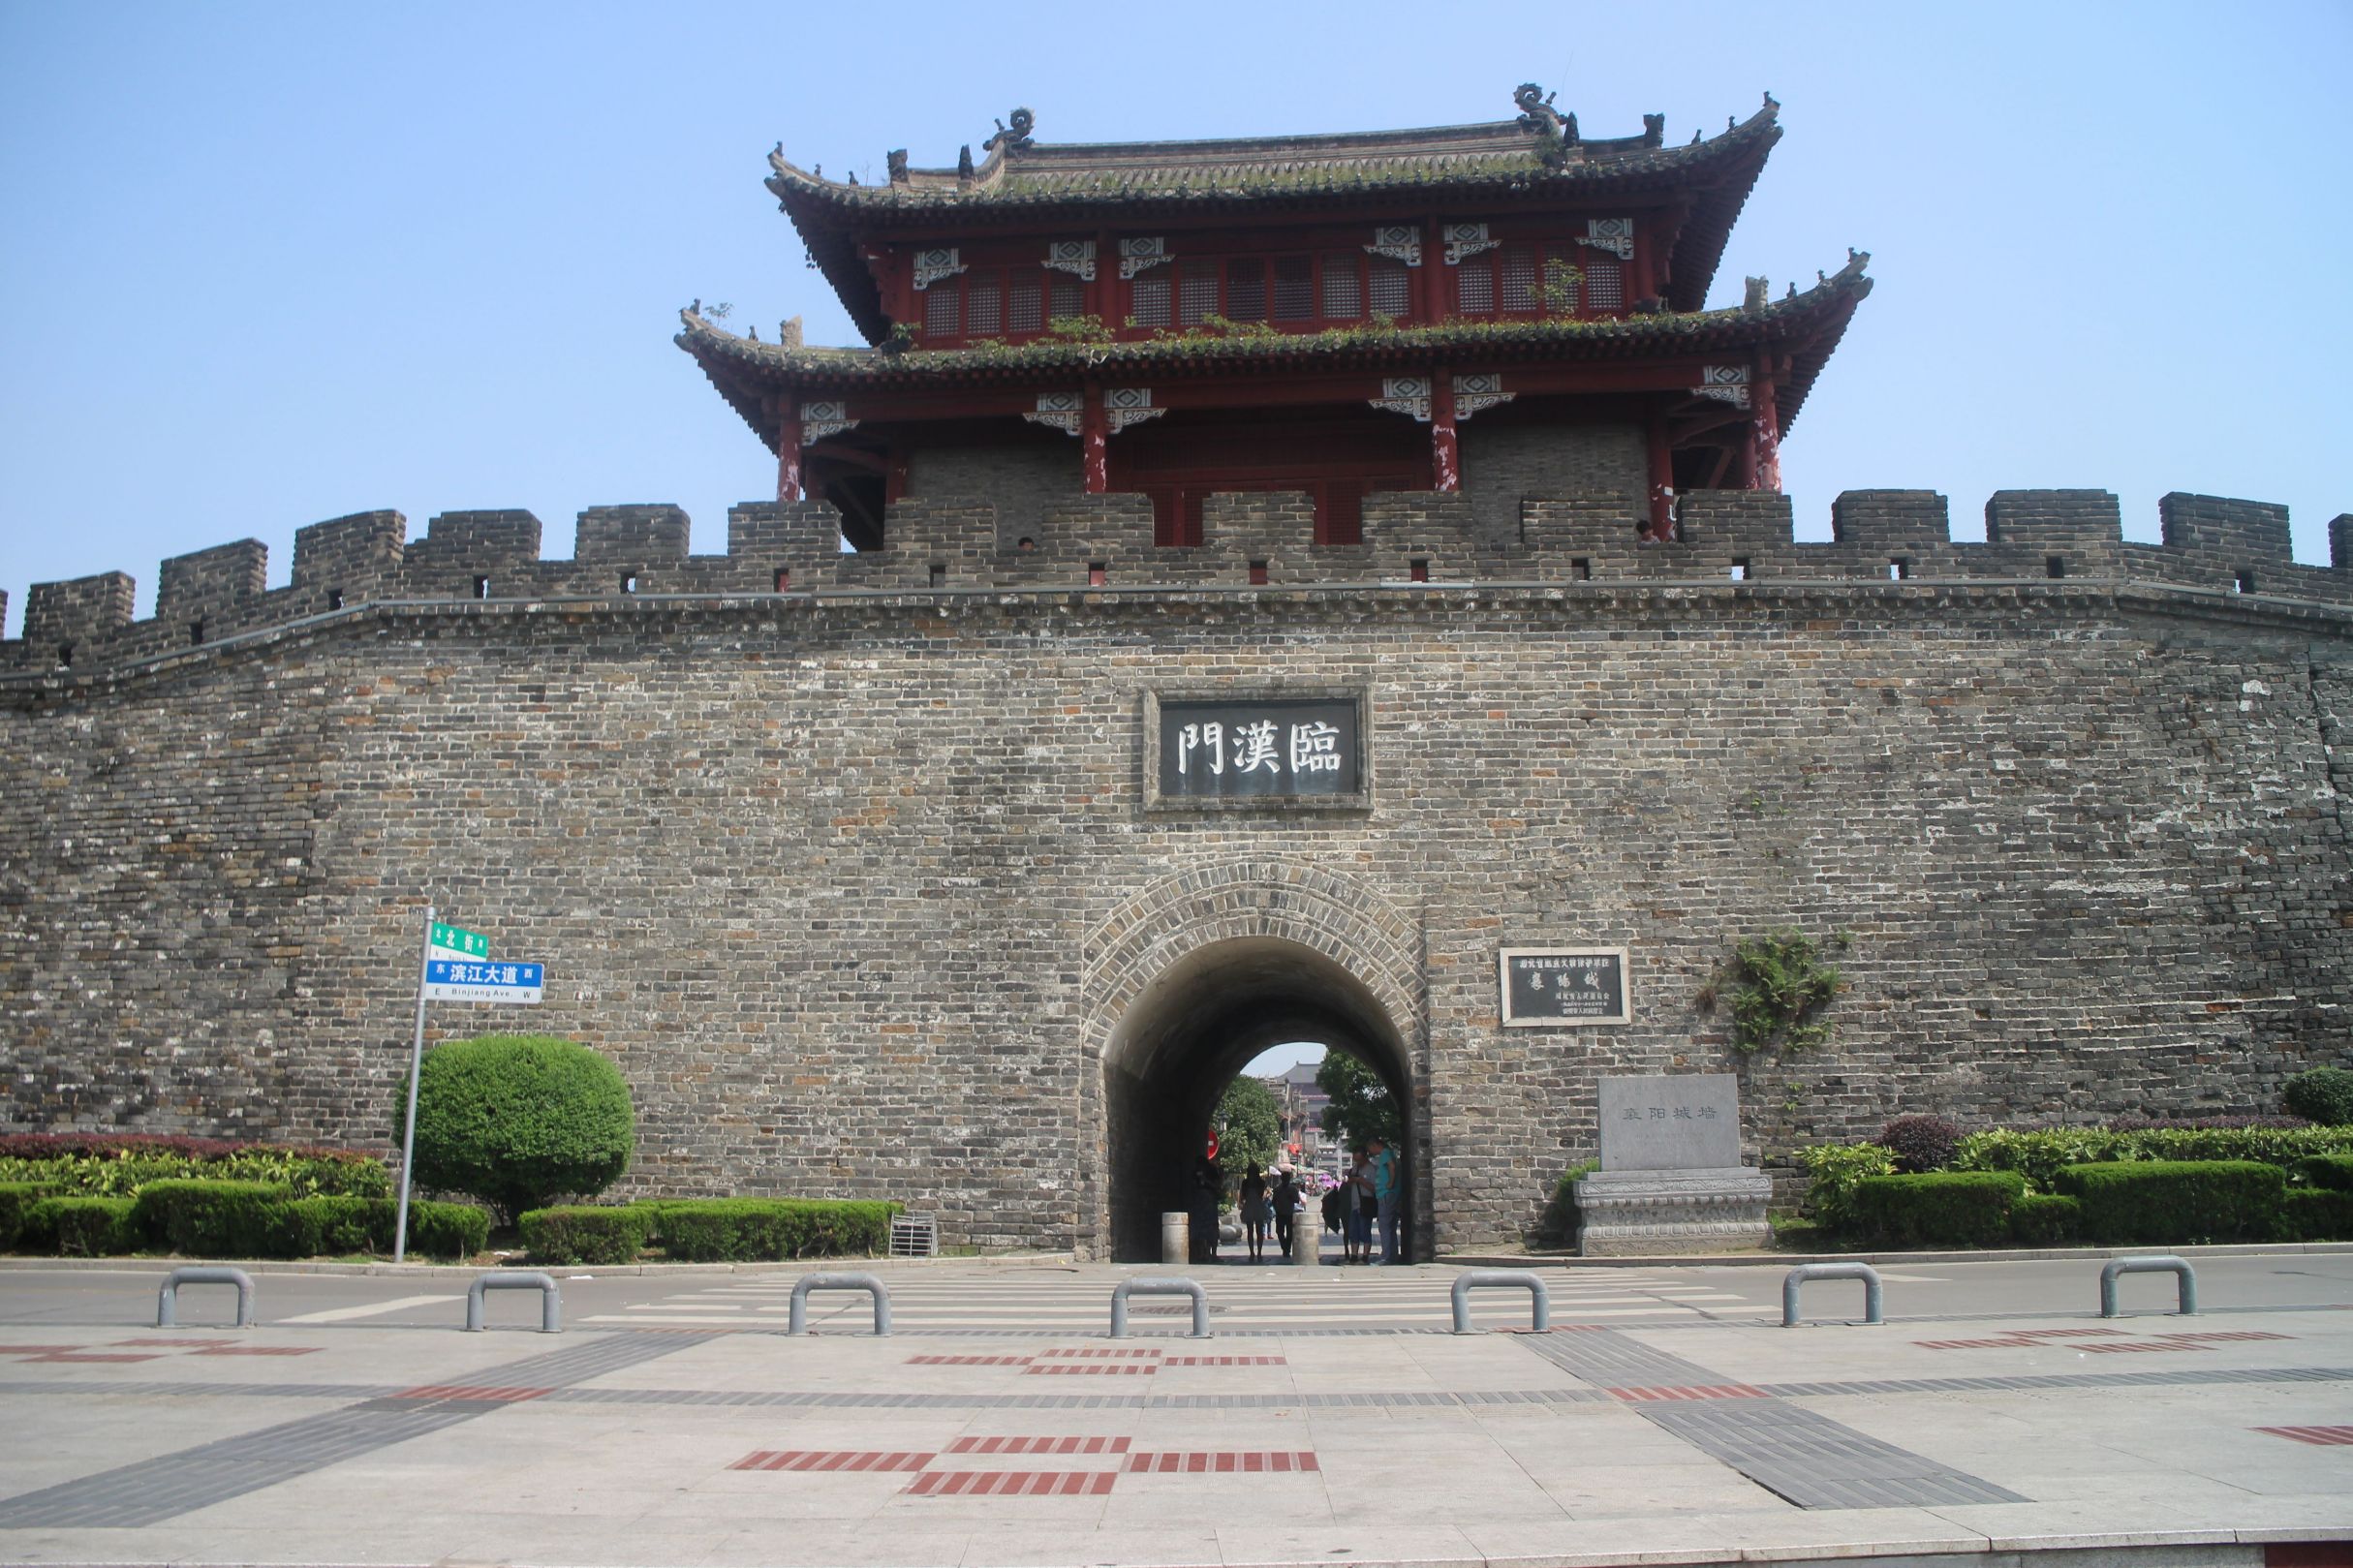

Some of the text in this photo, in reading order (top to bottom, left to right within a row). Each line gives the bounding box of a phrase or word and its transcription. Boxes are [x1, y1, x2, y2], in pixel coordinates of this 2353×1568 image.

[447, 930, 474, 952] 北街
[436, 964, 533, 984] 东 滨江大道 西
[451, 987, 490, 998] Binjiang
[494, 989, 513, 998] Ave.
[523, 991, 531, 999] W
[1623, 1106, 1717, 1121] 襄阳城墙
